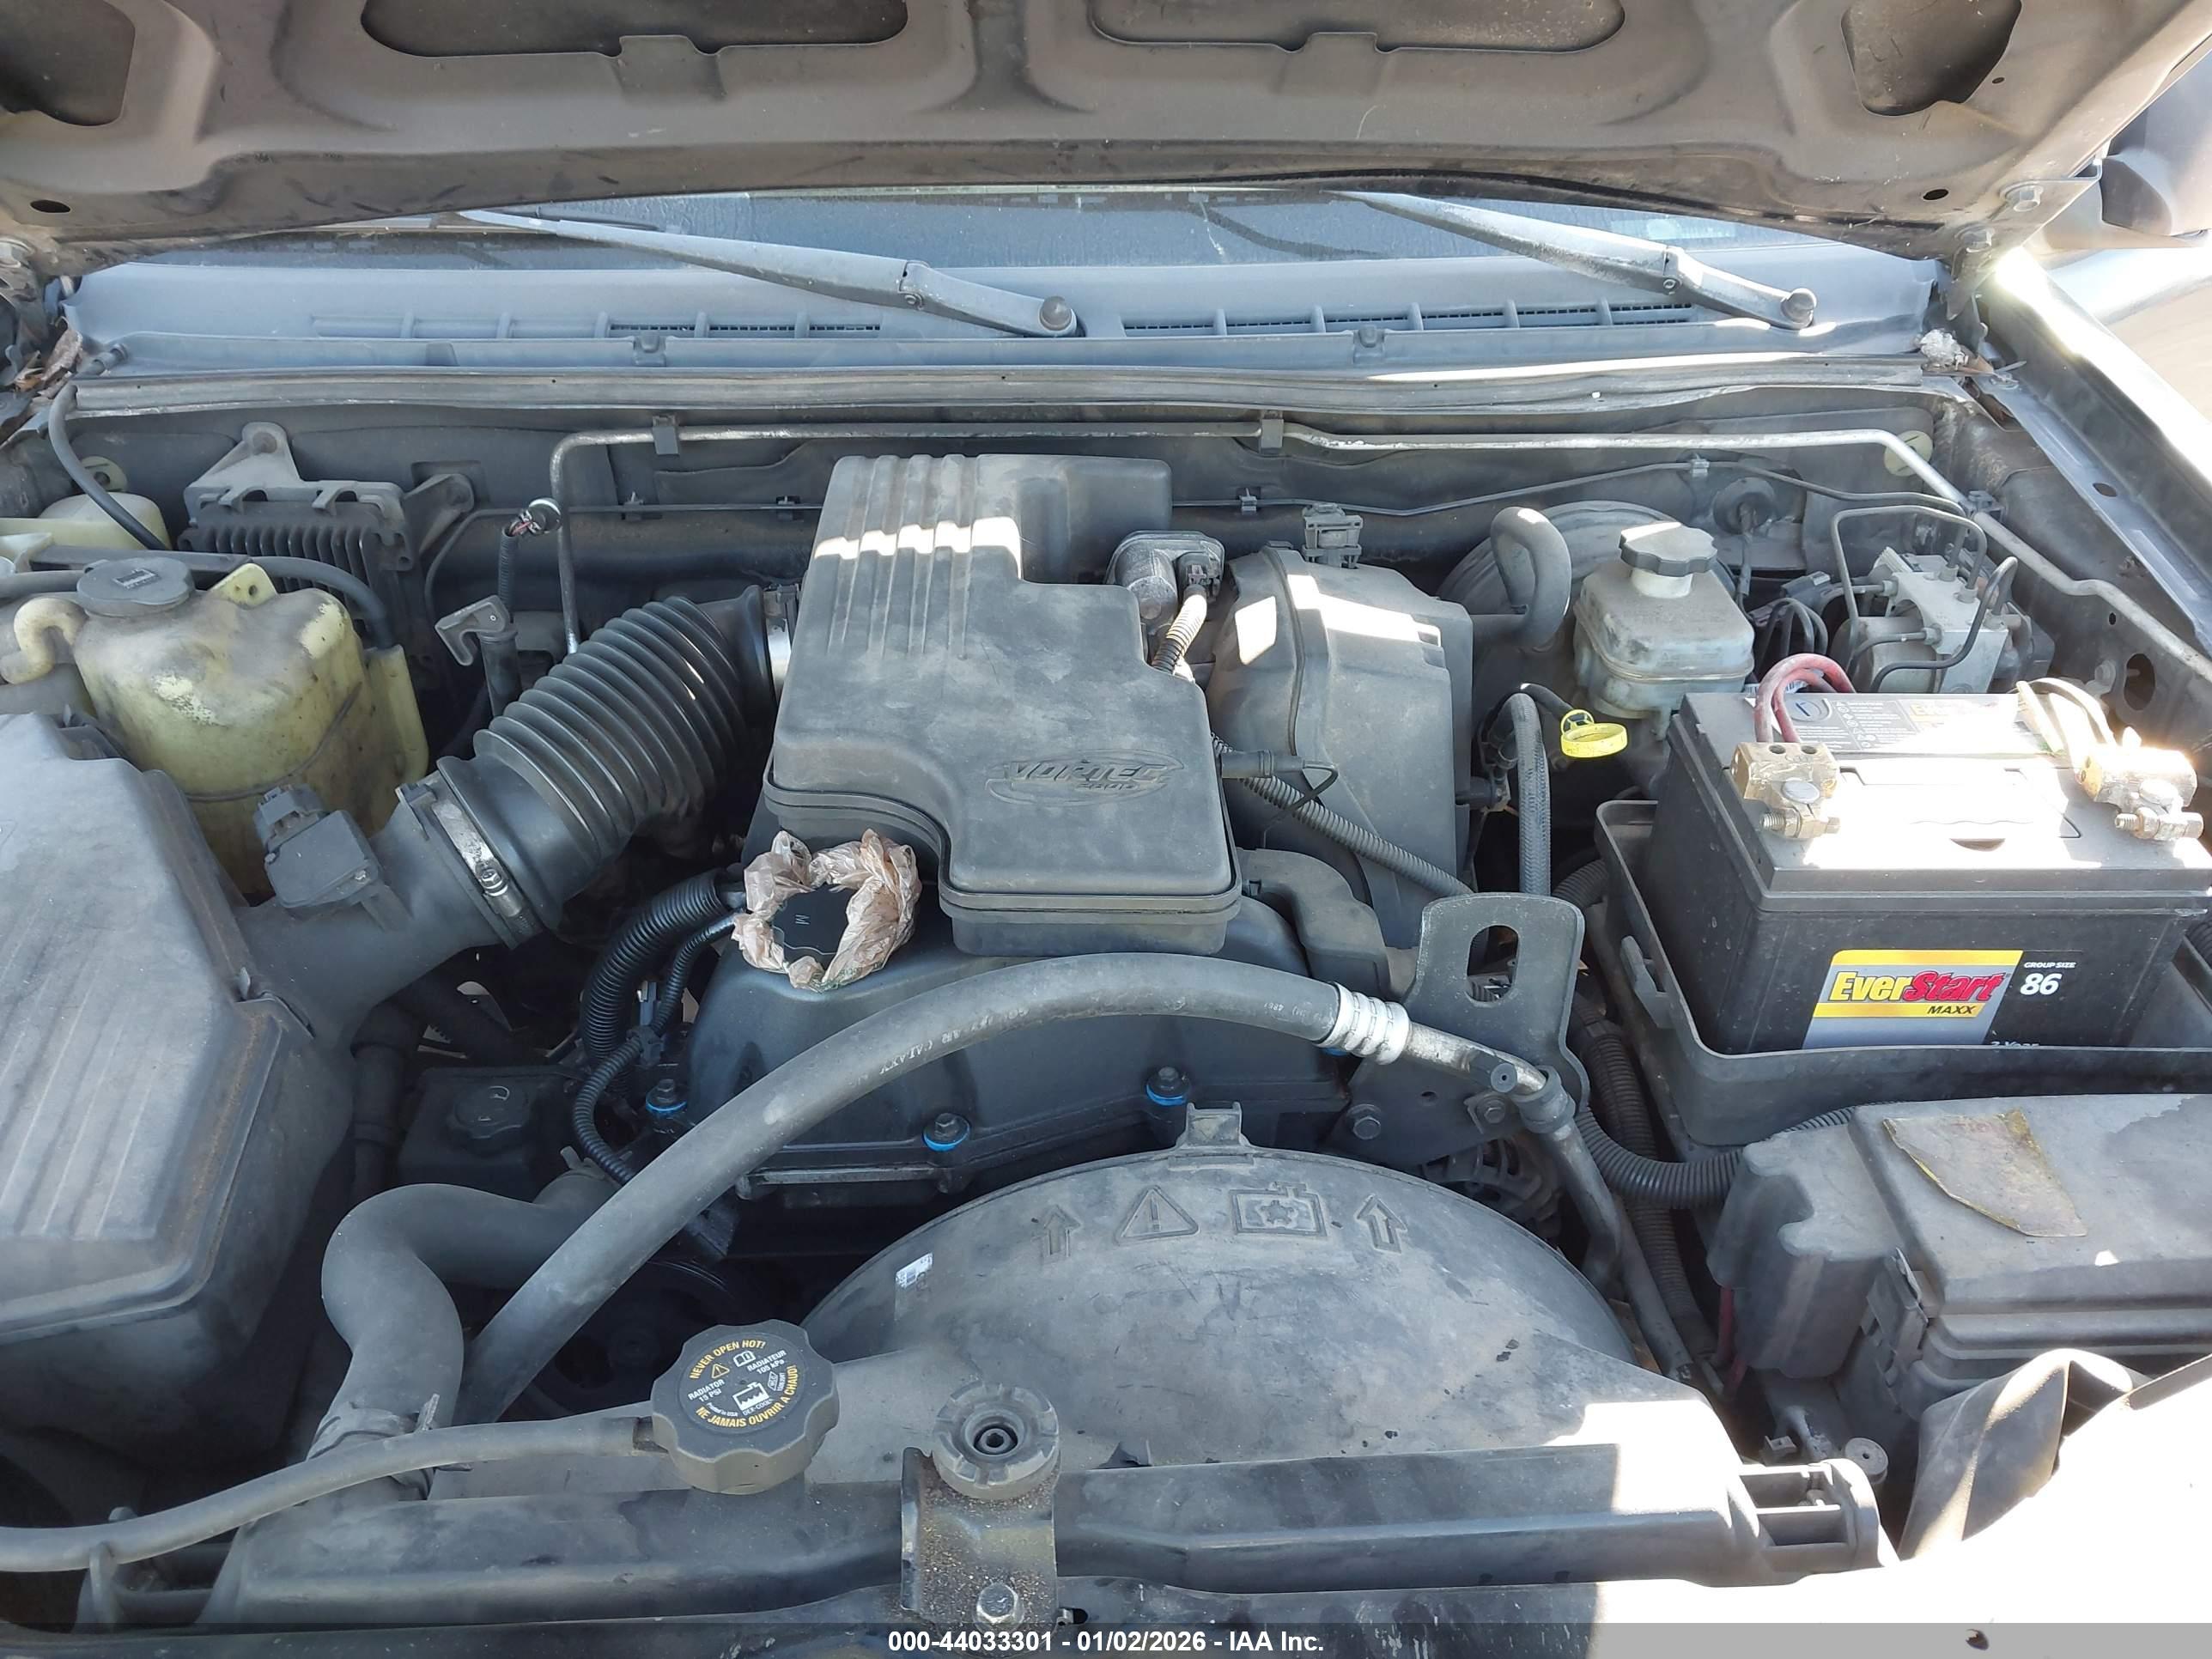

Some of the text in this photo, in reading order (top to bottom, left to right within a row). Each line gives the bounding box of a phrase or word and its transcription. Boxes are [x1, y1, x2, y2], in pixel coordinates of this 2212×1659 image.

[1008, 762, 1168, 782] VORTEC
[1828, 970, 2004, 1003] EverStart
[2020, 973, 2062, 995] 86
[1927, 1005, 1977, 1015] MAXX
[690, 1340, 766, 1379] NEVER OPEN HOT!
[747, 1350, 787, 1371] RADIATEUR
[757, 1359, 785, 1374] 105 kPa
[688, 1379, 726, 1401] RADIATOR
[696, 1407, 711, 1419] NE
[708, 1414, 747, 1427] JAMAIS
[749, 1402, 785, 1425] OUVRIR
[784, 1364, 799, 1395] CHAUD!
[699, 1389, 722, 1402] 15 PSI
